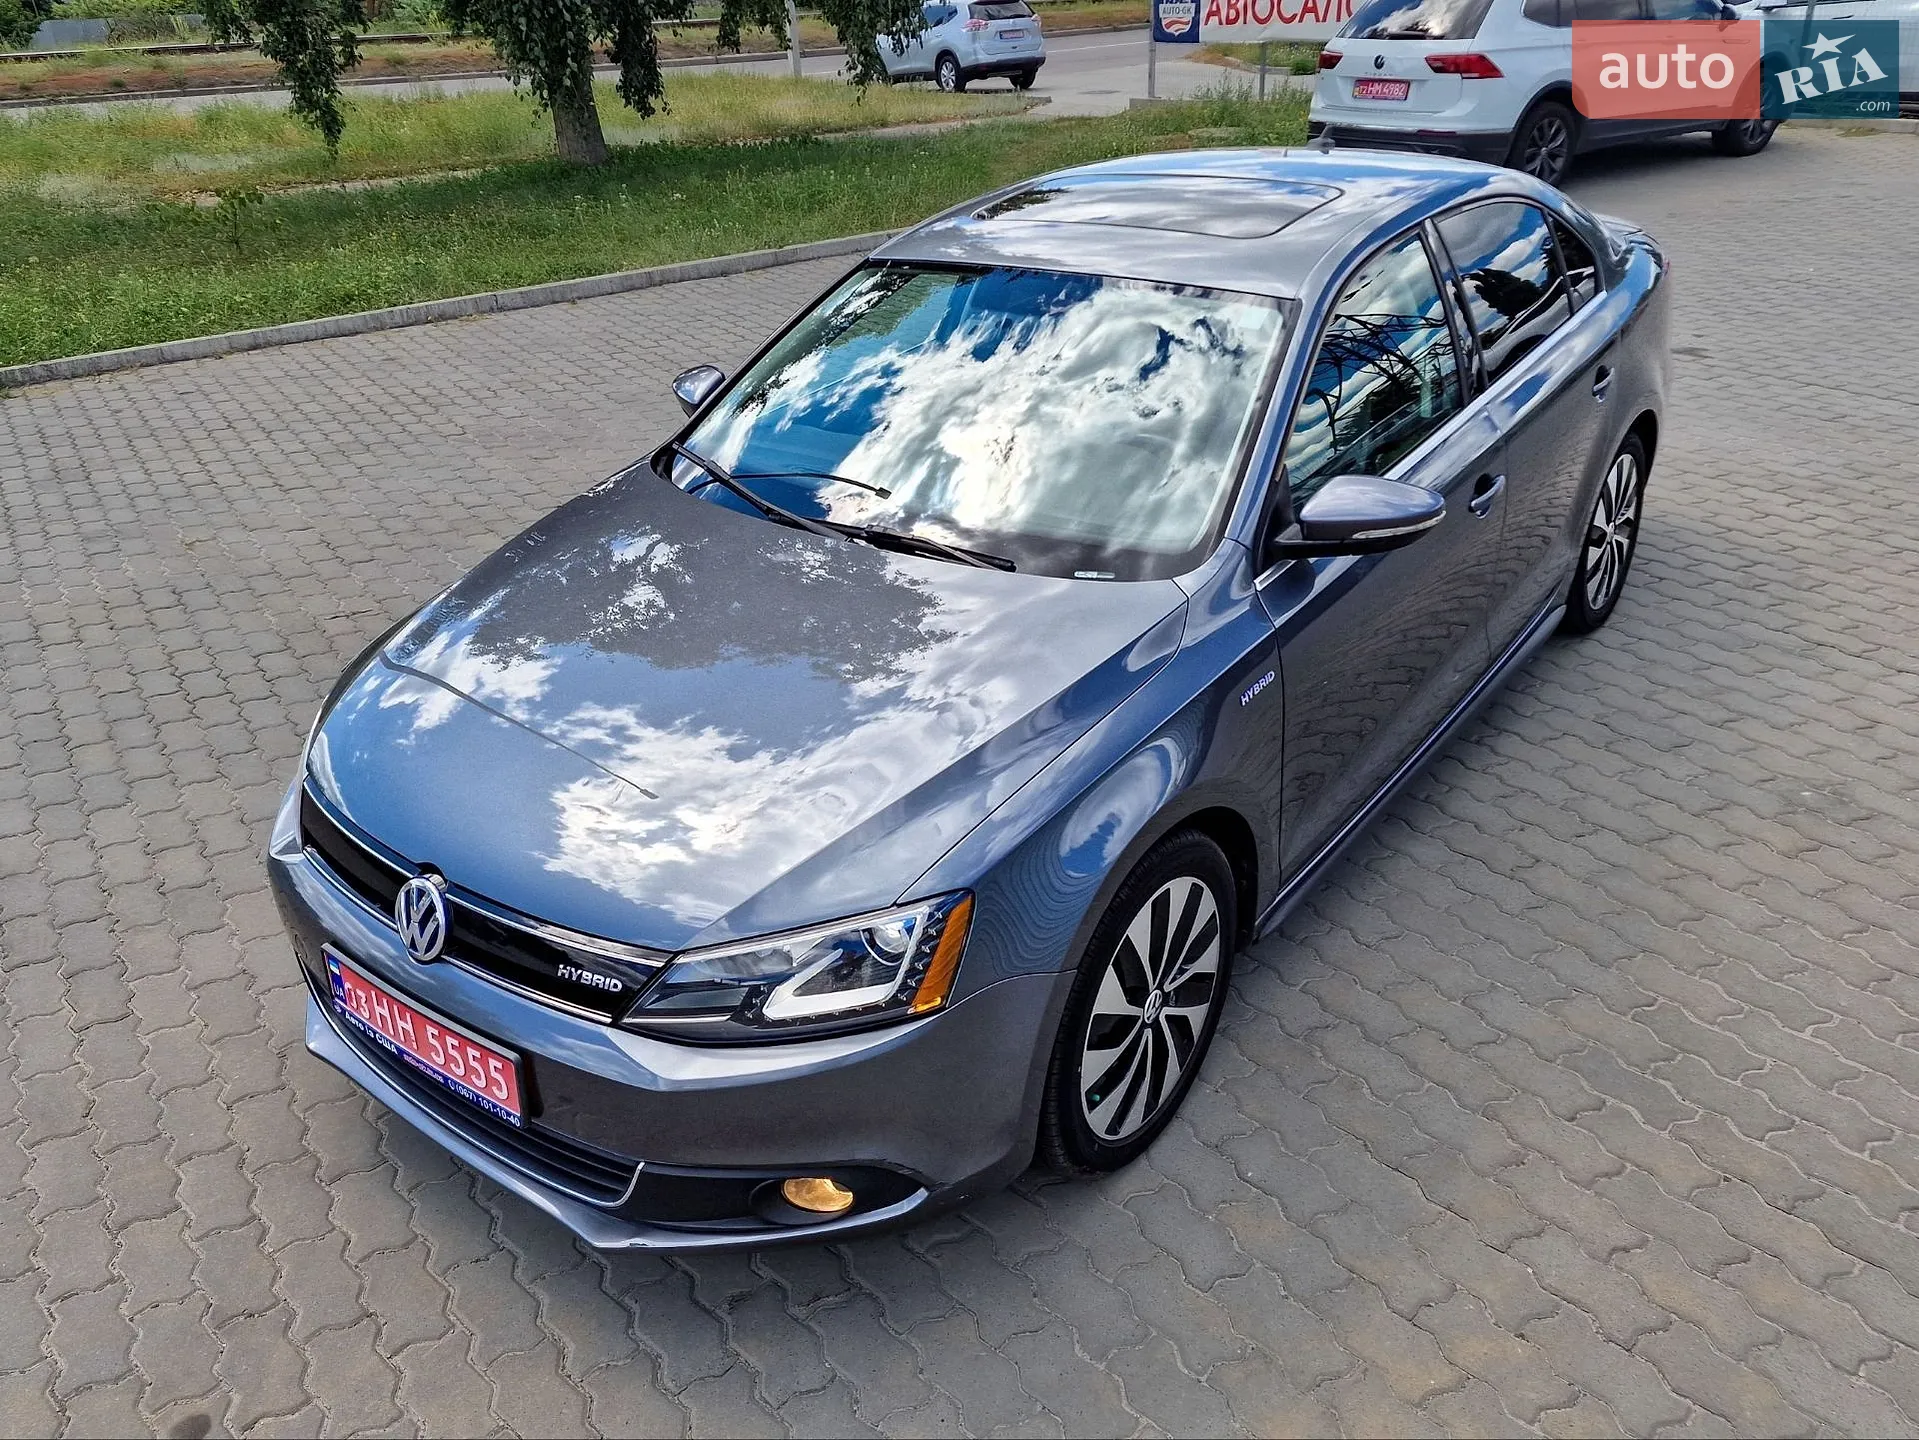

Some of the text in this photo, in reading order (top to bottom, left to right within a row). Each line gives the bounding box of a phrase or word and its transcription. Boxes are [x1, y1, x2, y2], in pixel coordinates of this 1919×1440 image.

[1240, 670, 1276, 707] HYBRID
[333, 982, 346, 1000] UA
[557, 963, 623, 992] HYBRID
